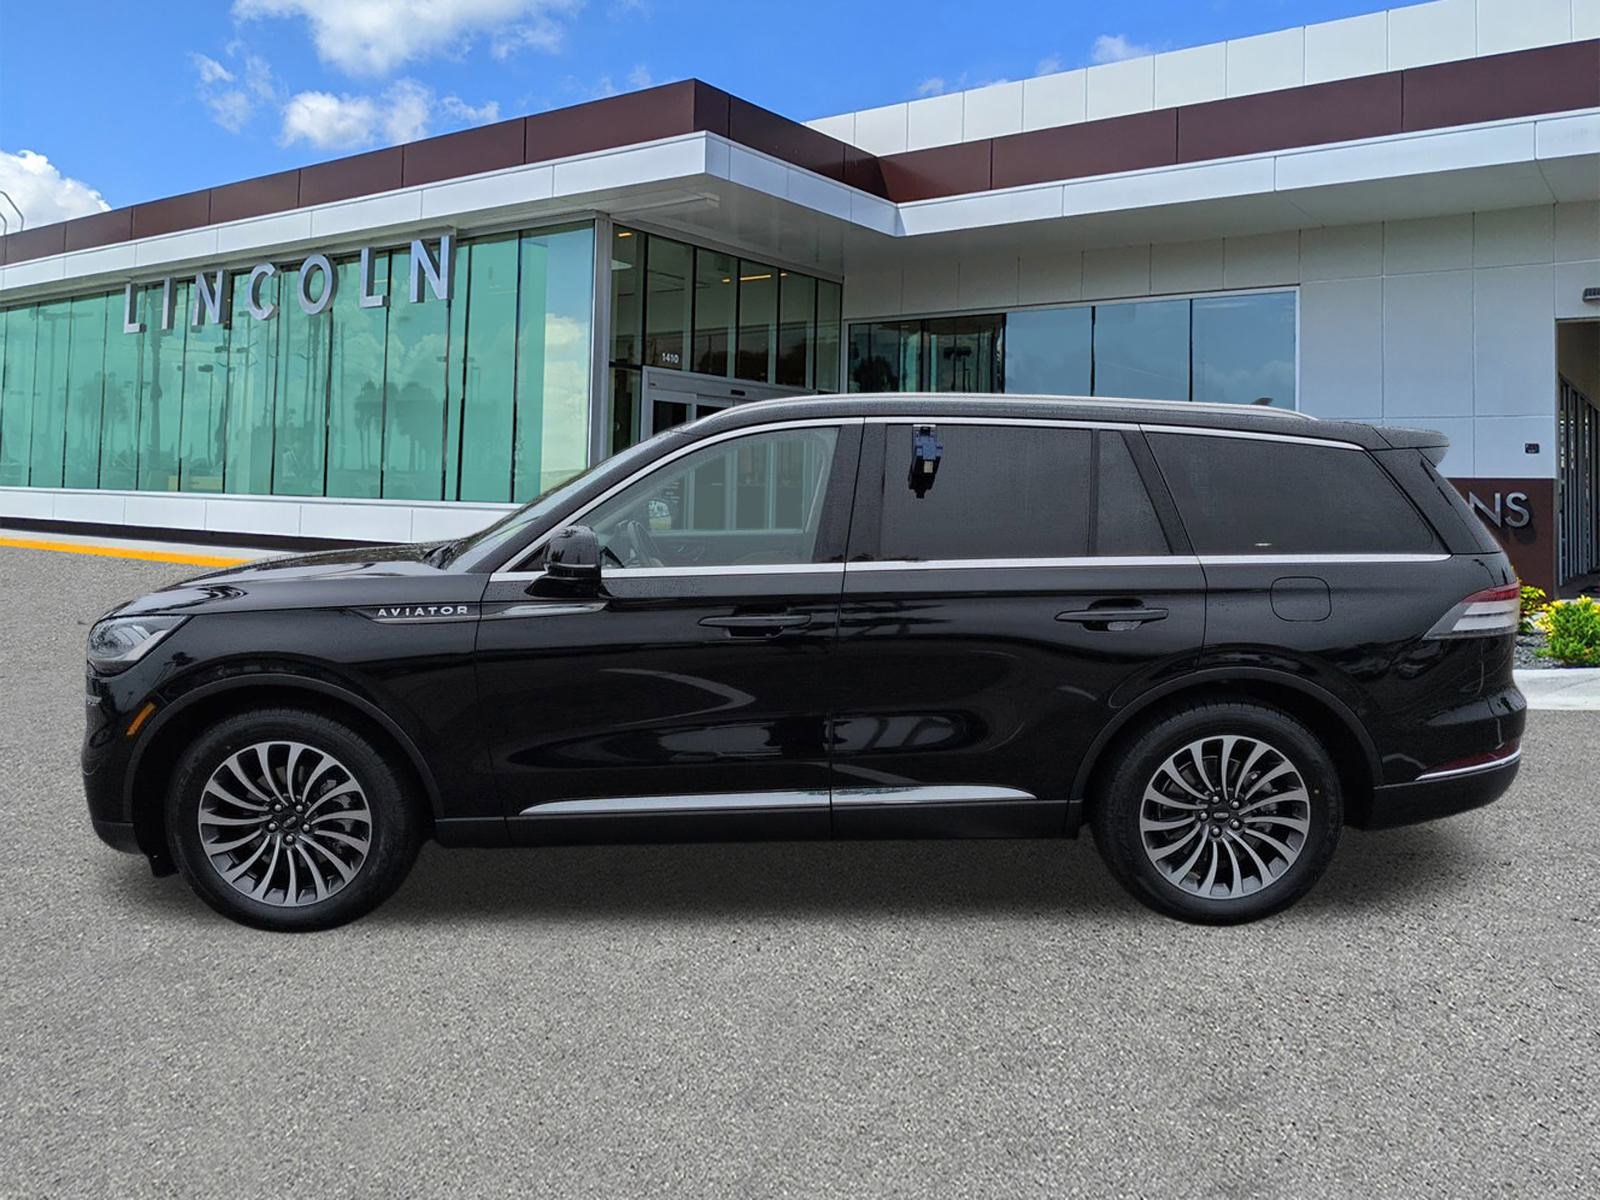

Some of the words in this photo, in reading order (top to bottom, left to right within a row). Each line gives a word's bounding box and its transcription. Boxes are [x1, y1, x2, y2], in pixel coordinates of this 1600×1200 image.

[123, 235, 454, 334] LINCOLN
[662, 352, 680, 363] 1410
[377, 605, 468, 617] AVIATOR
